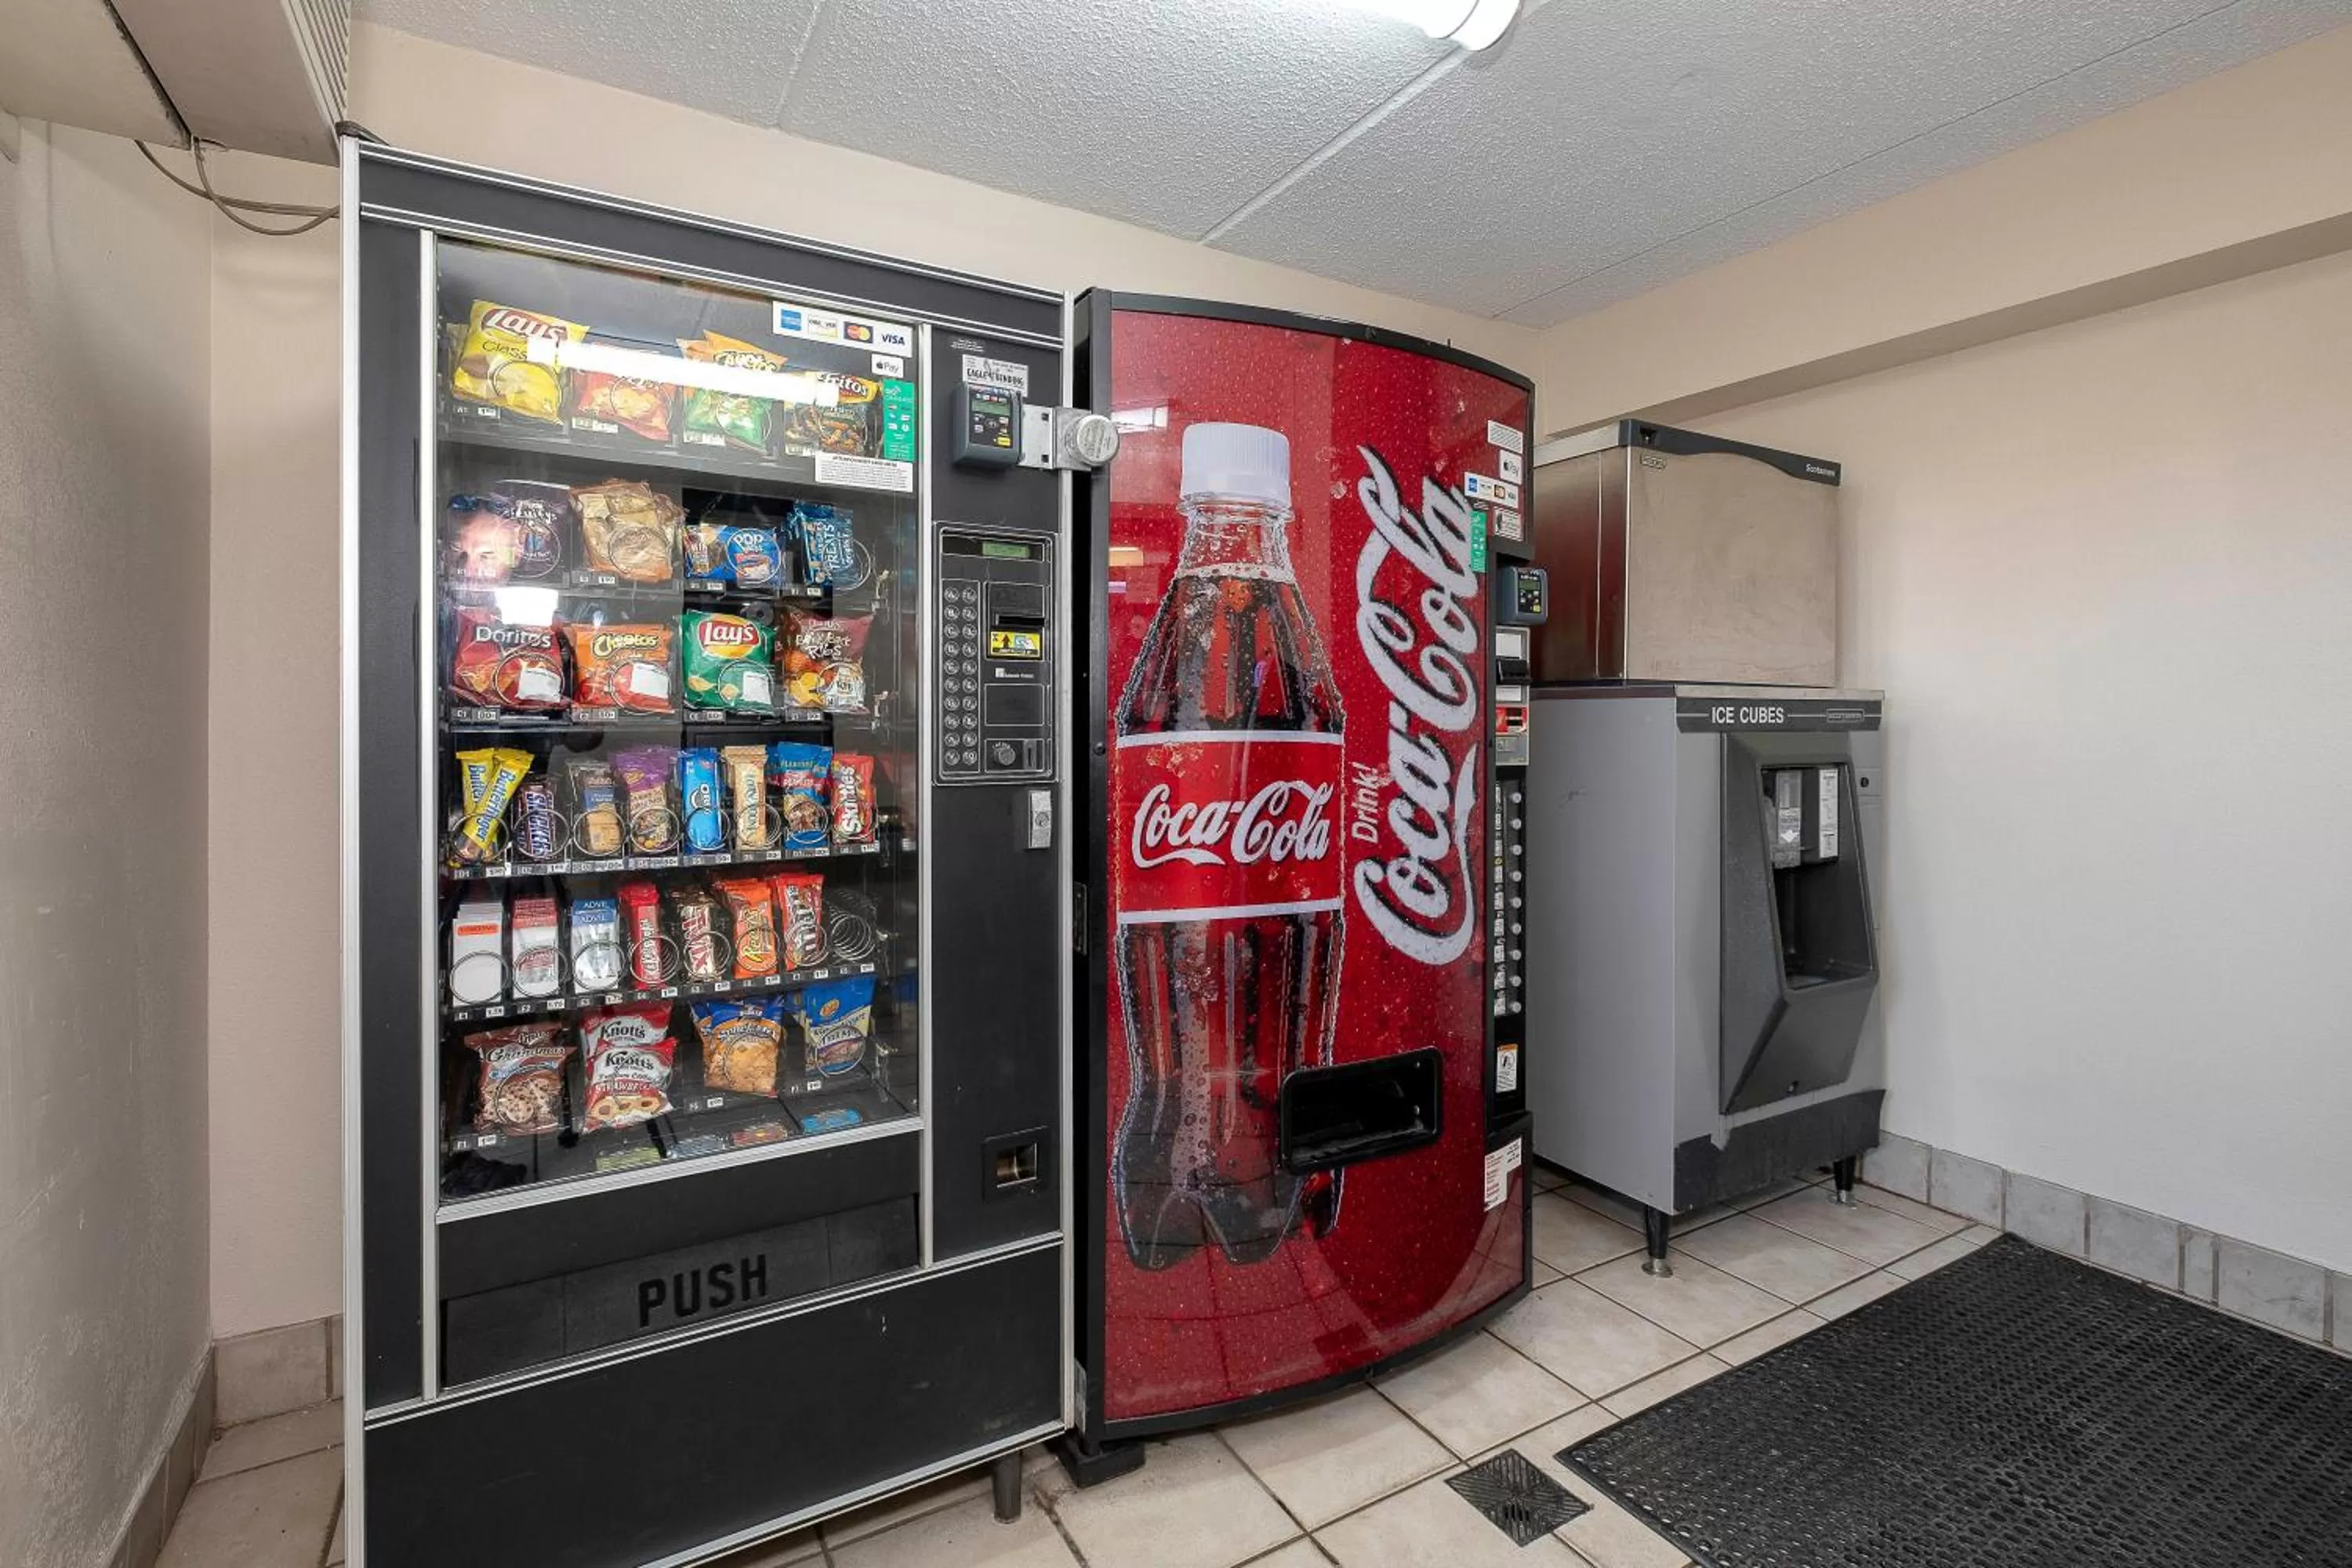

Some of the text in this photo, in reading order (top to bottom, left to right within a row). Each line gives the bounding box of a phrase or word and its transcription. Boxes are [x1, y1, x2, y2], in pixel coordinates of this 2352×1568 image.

[482, 340, 529, 360] Class
[882, 334, 906, 346] VISA
[884, 361, 899, 373] Pay
[475, 626, 551, 648] Doritos
[704, 621, 755, 645] Lay's
[1357, 444, 1480, 966] Coca-Cola
[1711, 706, 1784, 724] ICE CUBES
[476, 768, 516, 843] Butterfinger
[838, 764, 862, 834] Skittles
[1348, 760, 1379, 844] Drink!
[1131, 780, 1334, 868] Coca-Cola
[600, 1021, 646, 1039] Knott's
[605, 1051, 655, 1069] Knott's
[638, 1254, 766, 1329] PUSH
